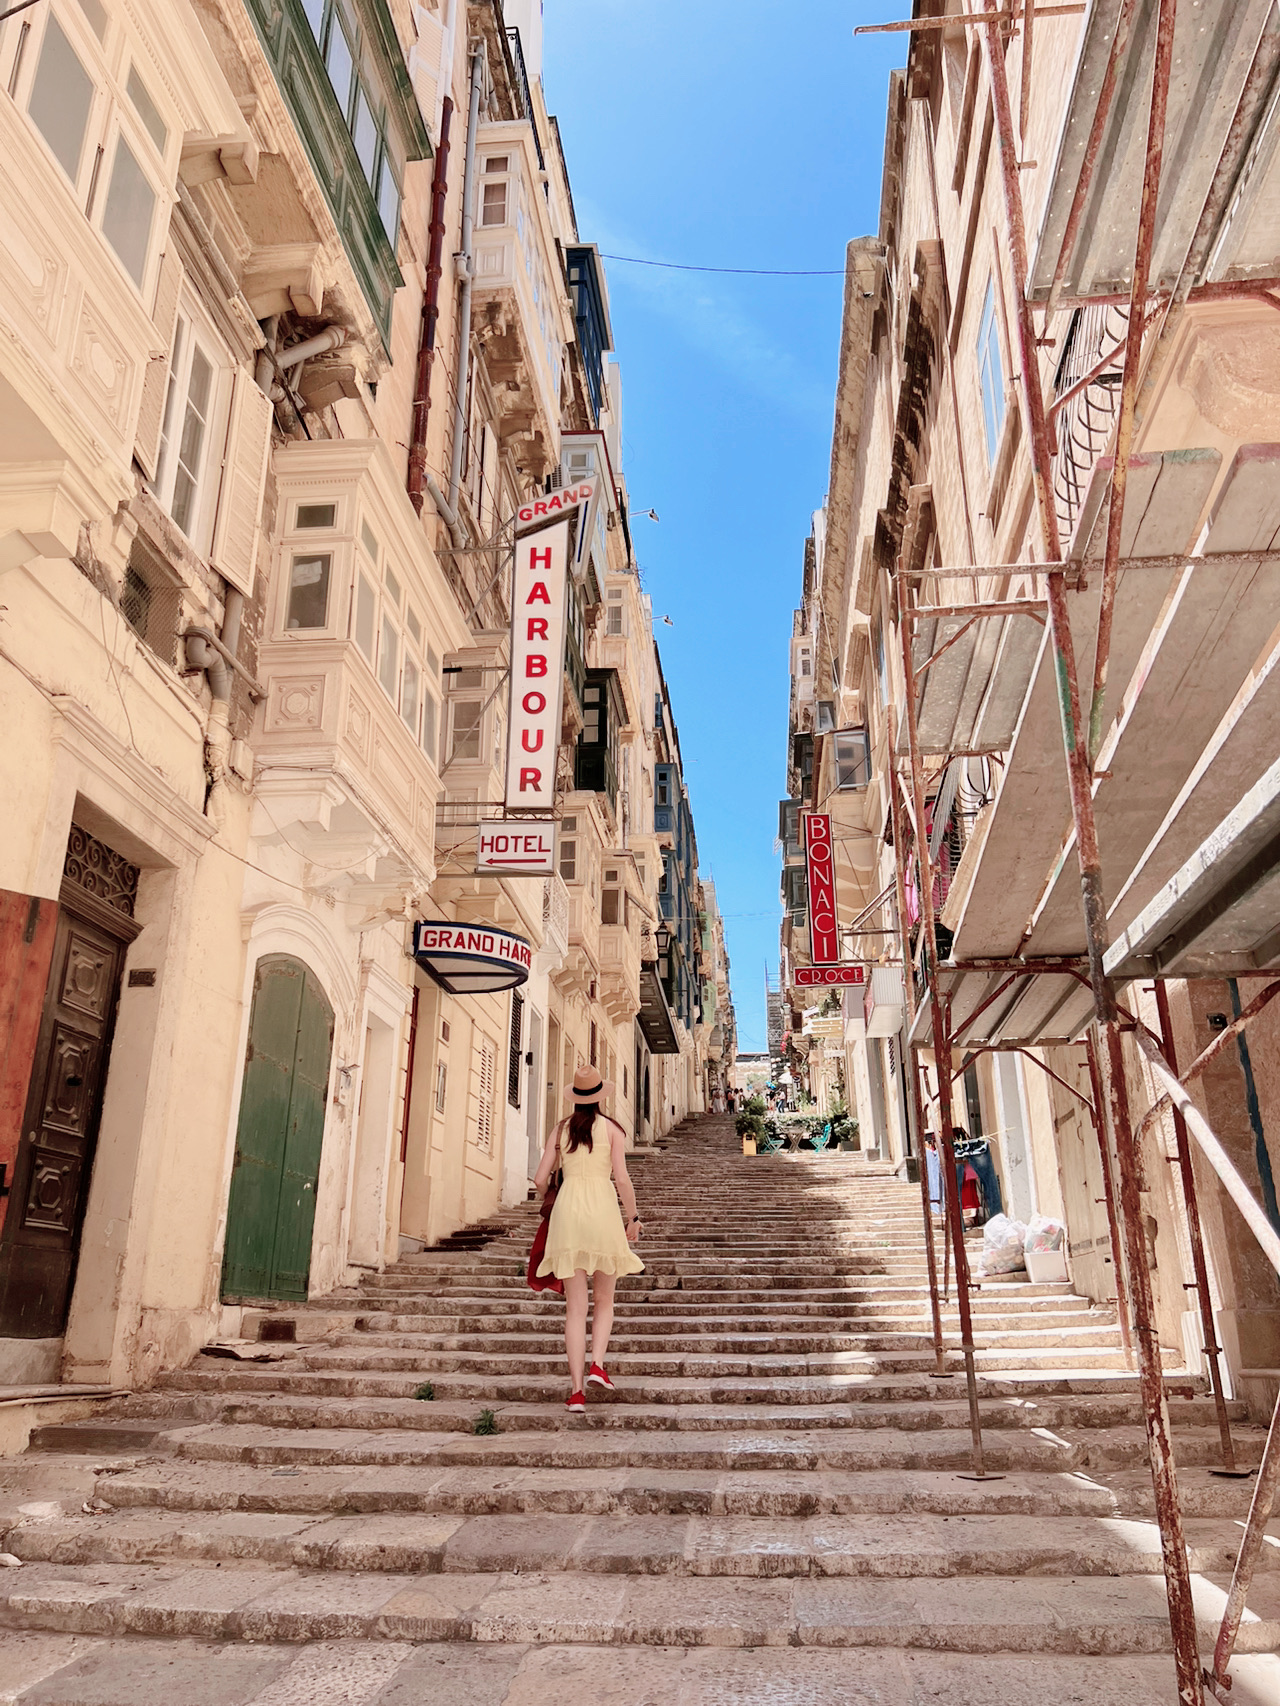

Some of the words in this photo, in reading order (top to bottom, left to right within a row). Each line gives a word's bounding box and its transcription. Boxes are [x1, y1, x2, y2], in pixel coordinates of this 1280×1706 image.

[519, 485, 593, 521] GRAND
[519, 547, 552, 792] HARBOUR
[481, 835, 551, 853] HOTEL
[809, 817, 835, 958] BONACI
[423, 930, 494, 953] GRAND
